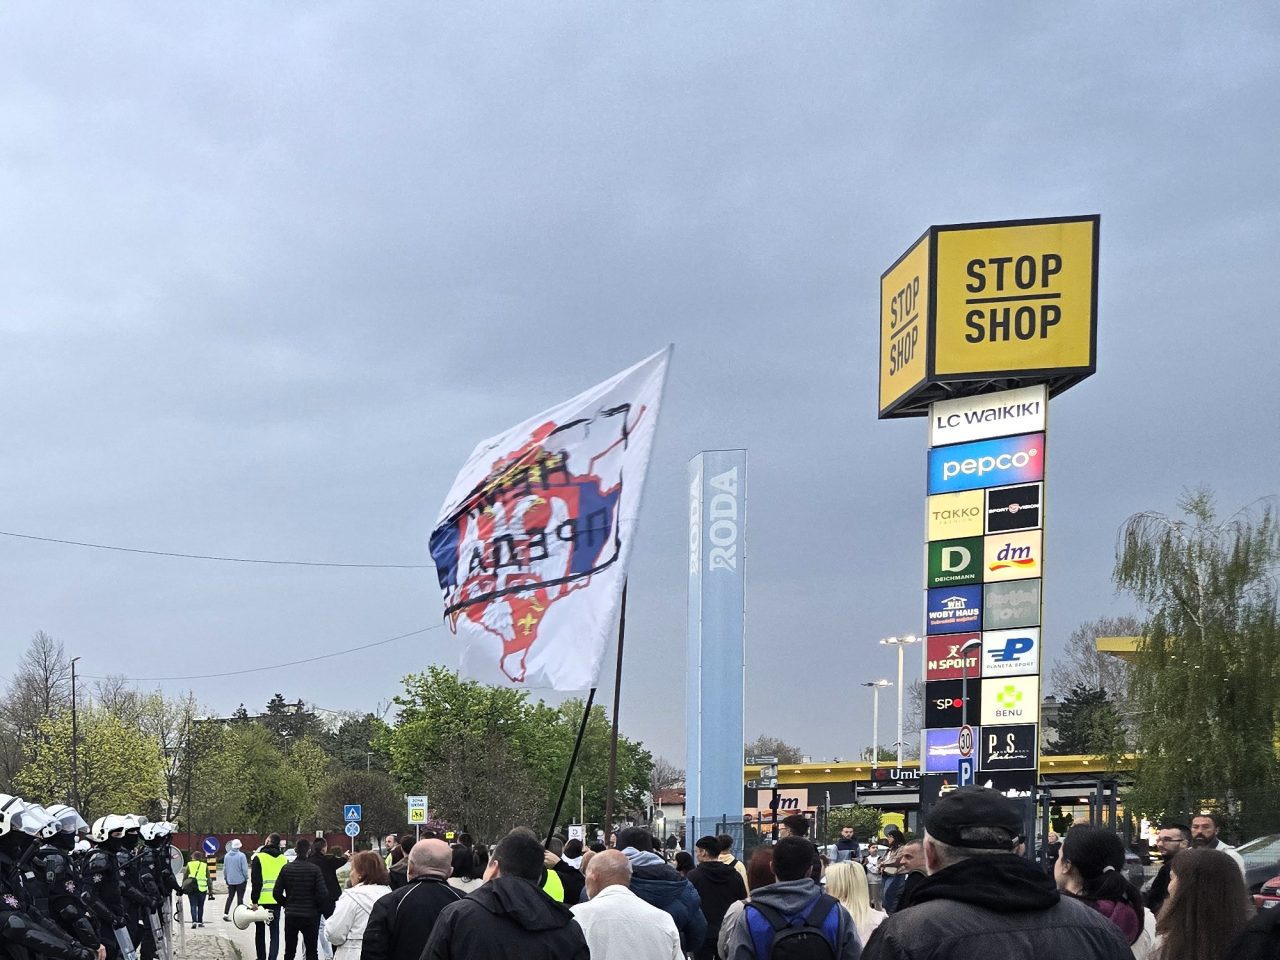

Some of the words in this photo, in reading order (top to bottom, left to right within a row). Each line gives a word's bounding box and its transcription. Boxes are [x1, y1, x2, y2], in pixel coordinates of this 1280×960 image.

[966, 253, 1062, 293] STOP
[890, 275, 920, 330] STOP
[965, 304, 1061, 343] SHOP
[889, 324, 918, 376] SHOP
[937, 413, 961, 429] LC
[943, 451, 1030, 480] pepco
[709, 466, 738, 573] RODA
[942, 546, 971, 572] D
[997, 543, 1031, 561] dm
[935, 574, 975, 582] DEICHMANN
[929, 610, 954, 618] WOBY
[955, 608, 979, 617] HAUS
[947, 599, 961, 608] WH
[938, 658, 977, 670] SPORT
[995, 709, 1023, 717] BENU
[960, 733, 970, 750] 30
[961, 762, 971, 786] P
